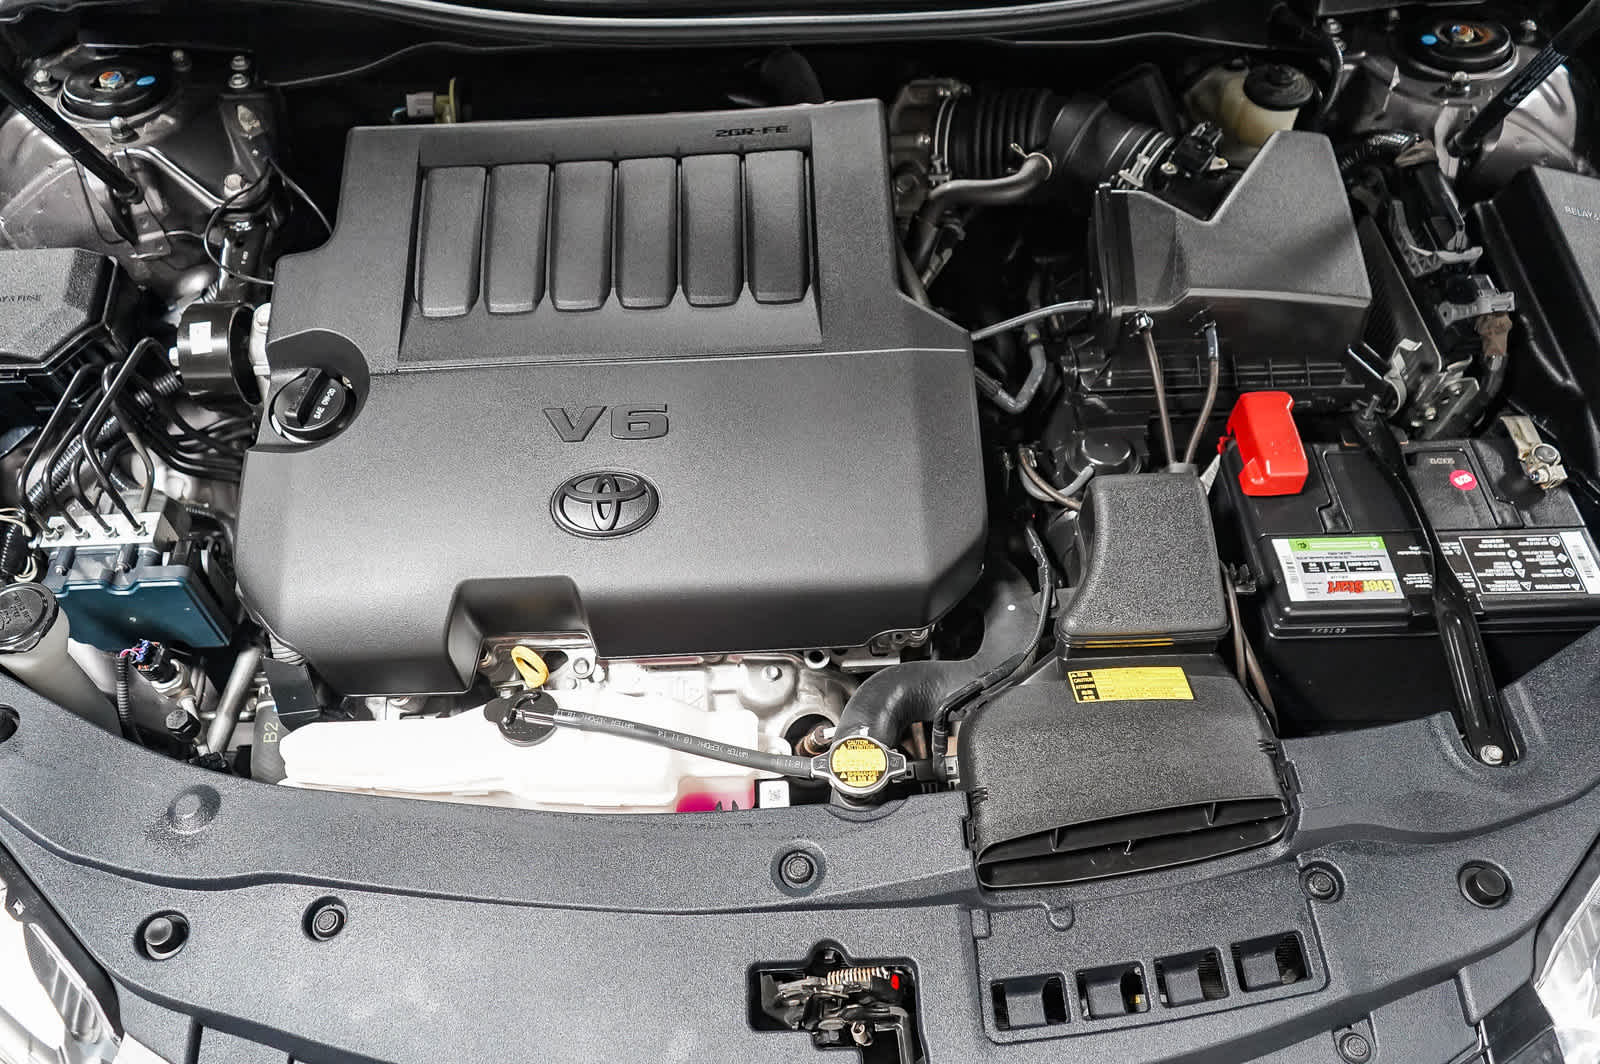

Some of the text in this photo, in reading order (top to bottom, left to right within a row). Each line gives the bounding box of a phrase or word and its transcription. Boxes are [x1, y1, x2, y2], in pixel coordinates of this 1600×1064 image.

[712, 125, 791, 138] 2GR-FE
[313, 406, 325, 419] SAE
[542, 403, 669, 442] V6
[263, 721, 279, 743] B2
